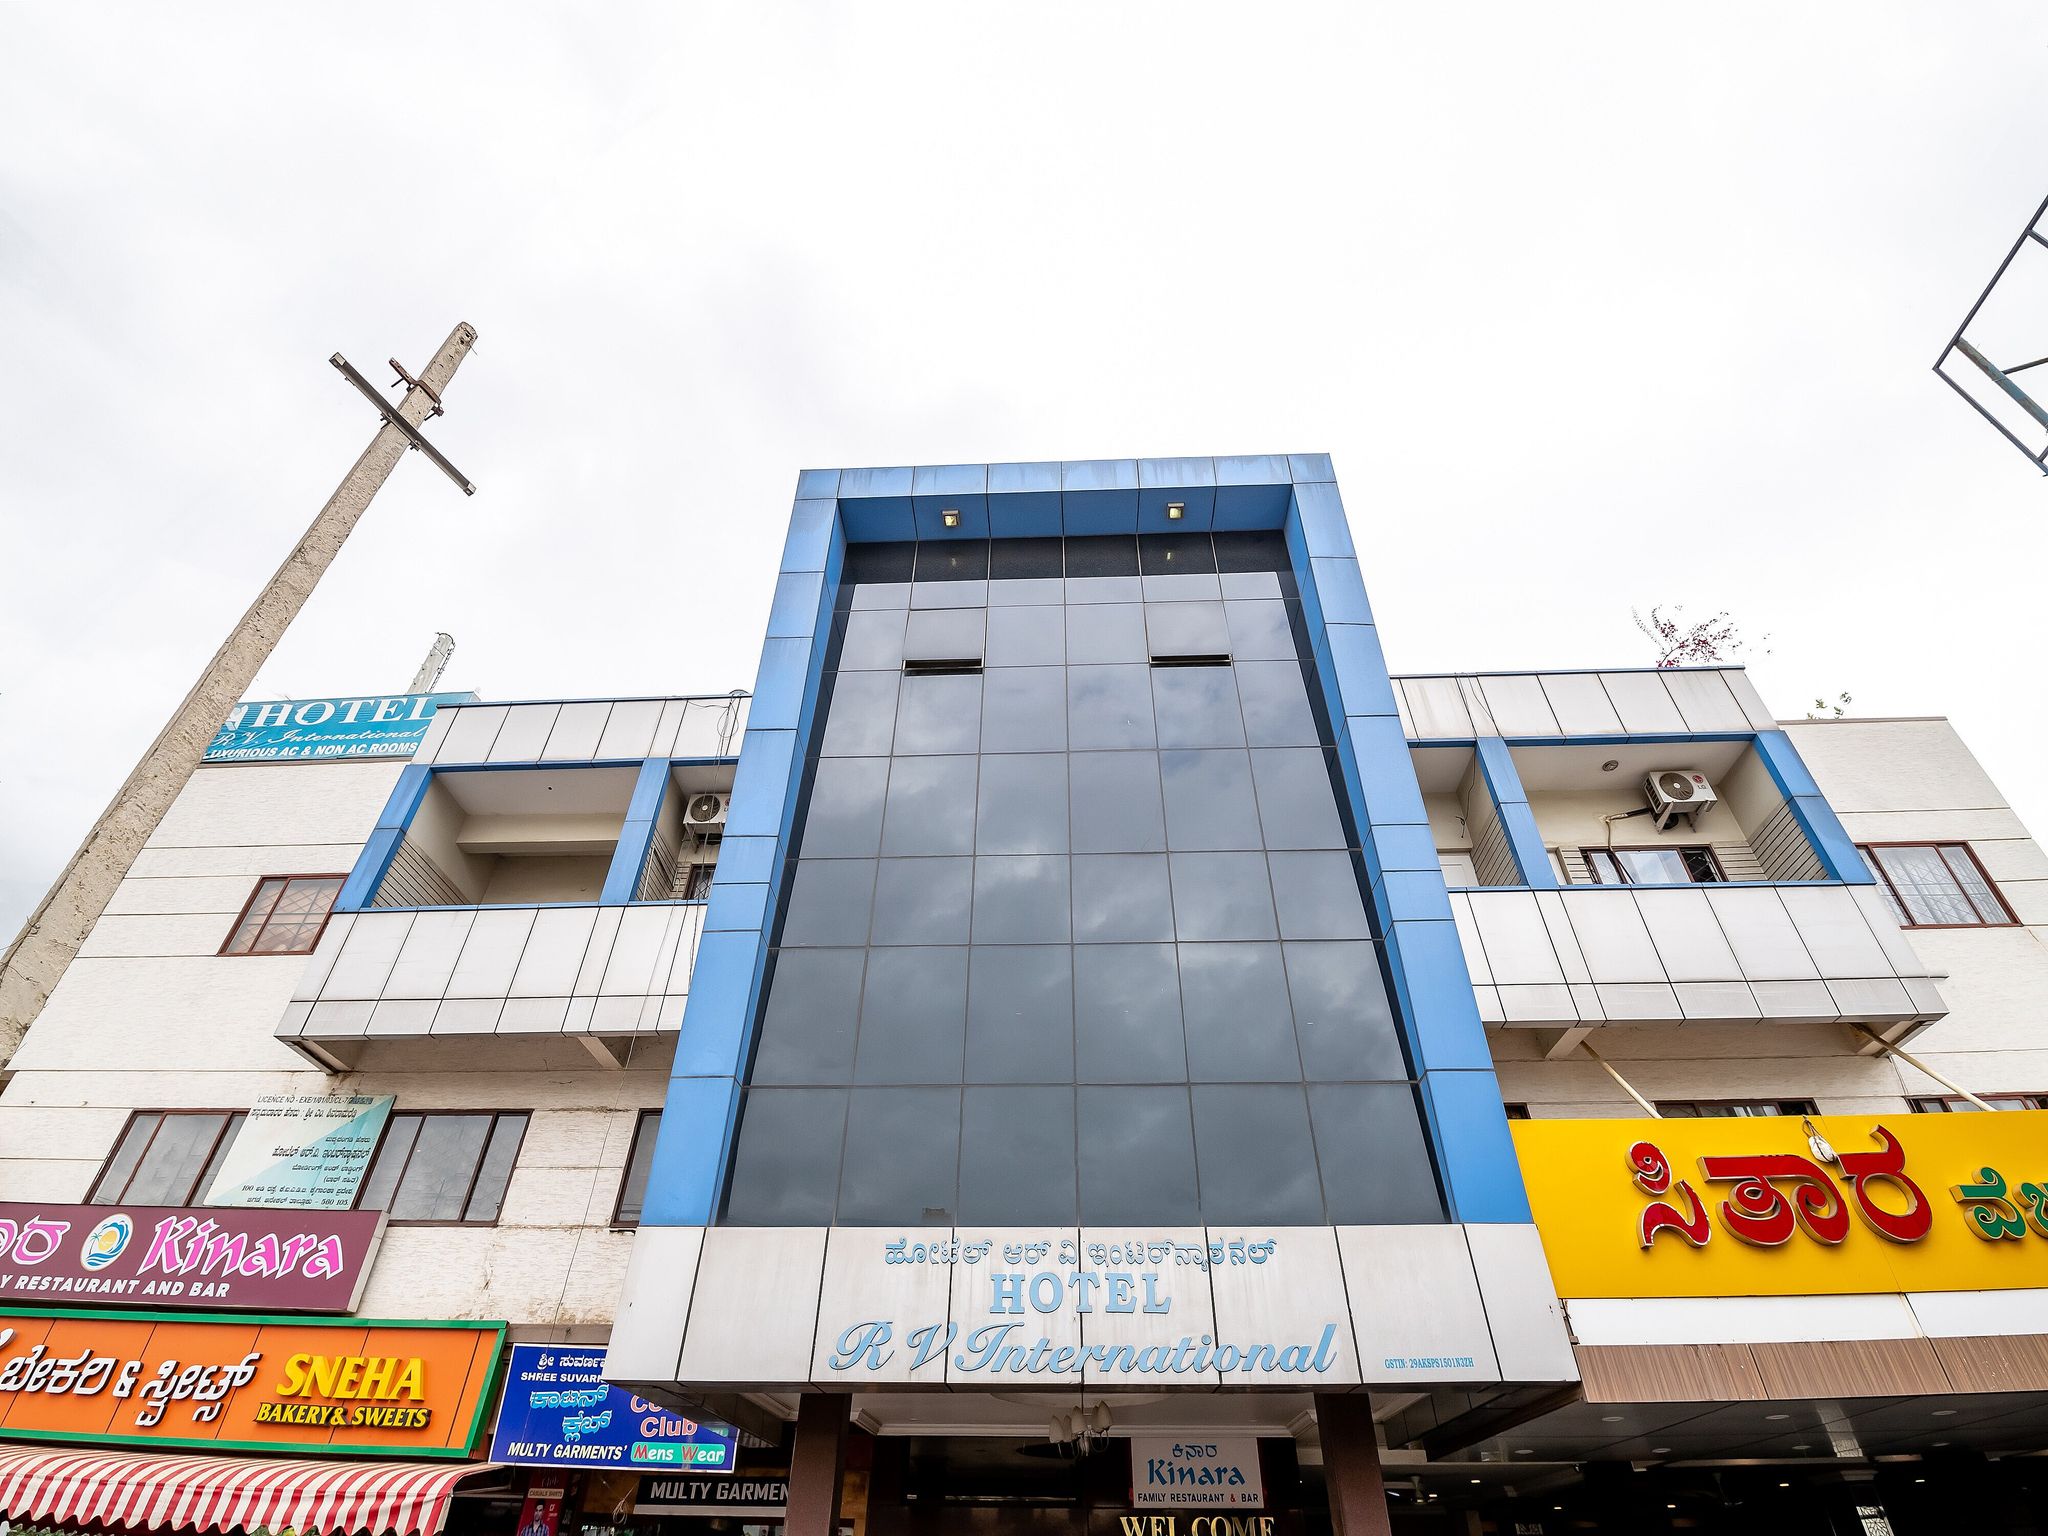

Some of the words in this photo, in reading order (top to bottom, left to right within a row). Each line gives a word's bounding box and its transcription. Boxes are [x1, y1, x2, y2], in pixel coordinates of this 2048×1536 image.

[249, 697, 437, 728] HOTEL
[267, 725, 428, 744] International
[278, 746, 299, 756] AC
[300, 745, 312, 755] &
[314, 744, 346, 755] NON
[345, 743, 368, 754] AC
[368, 742, 419, 753] ROOMS
[136, 1215, 344, 1281] Kinara
[1003, 1239, 1052, 1265] ಆರ್
[1058, 1239, 1078, 1265] ವಿ
[14, 1275, 140, 1294] RESTAURANT
[142, 1280, 185, 1296] AND
[188, 1282, 230, 1298] BAR
[989, 1271, 1172, 1315] HOTEL
[828, 1319, 895, 1371] R
[954, 1319, 1338, 1374] International
[276, 1353, 424, 1401] SNEHA
[520, 1371, 557, 1382] SHREE
[559, 1373, 603, 1383] SUVAR
[351, 1406, 428, 1428] SWEETS
[640, 1416, 698, 1438] Club
[507, 1442, 552, 1457] MULTY
[633, 1444, 674, 1461] Mens
[681, 1445, 725, 1463] Wear
[1147, 1458, 1246, 1486] Kinara
[650, 1481, 712, 1500] MULTY
[1137, 1492, 1166, 1502] FAMILY
[1170, 1492, 1225, 1503] RESTAURANT
[1230, 1493, 1237, 1503] &
[1241, 1492, 1259, 1503] BAR
